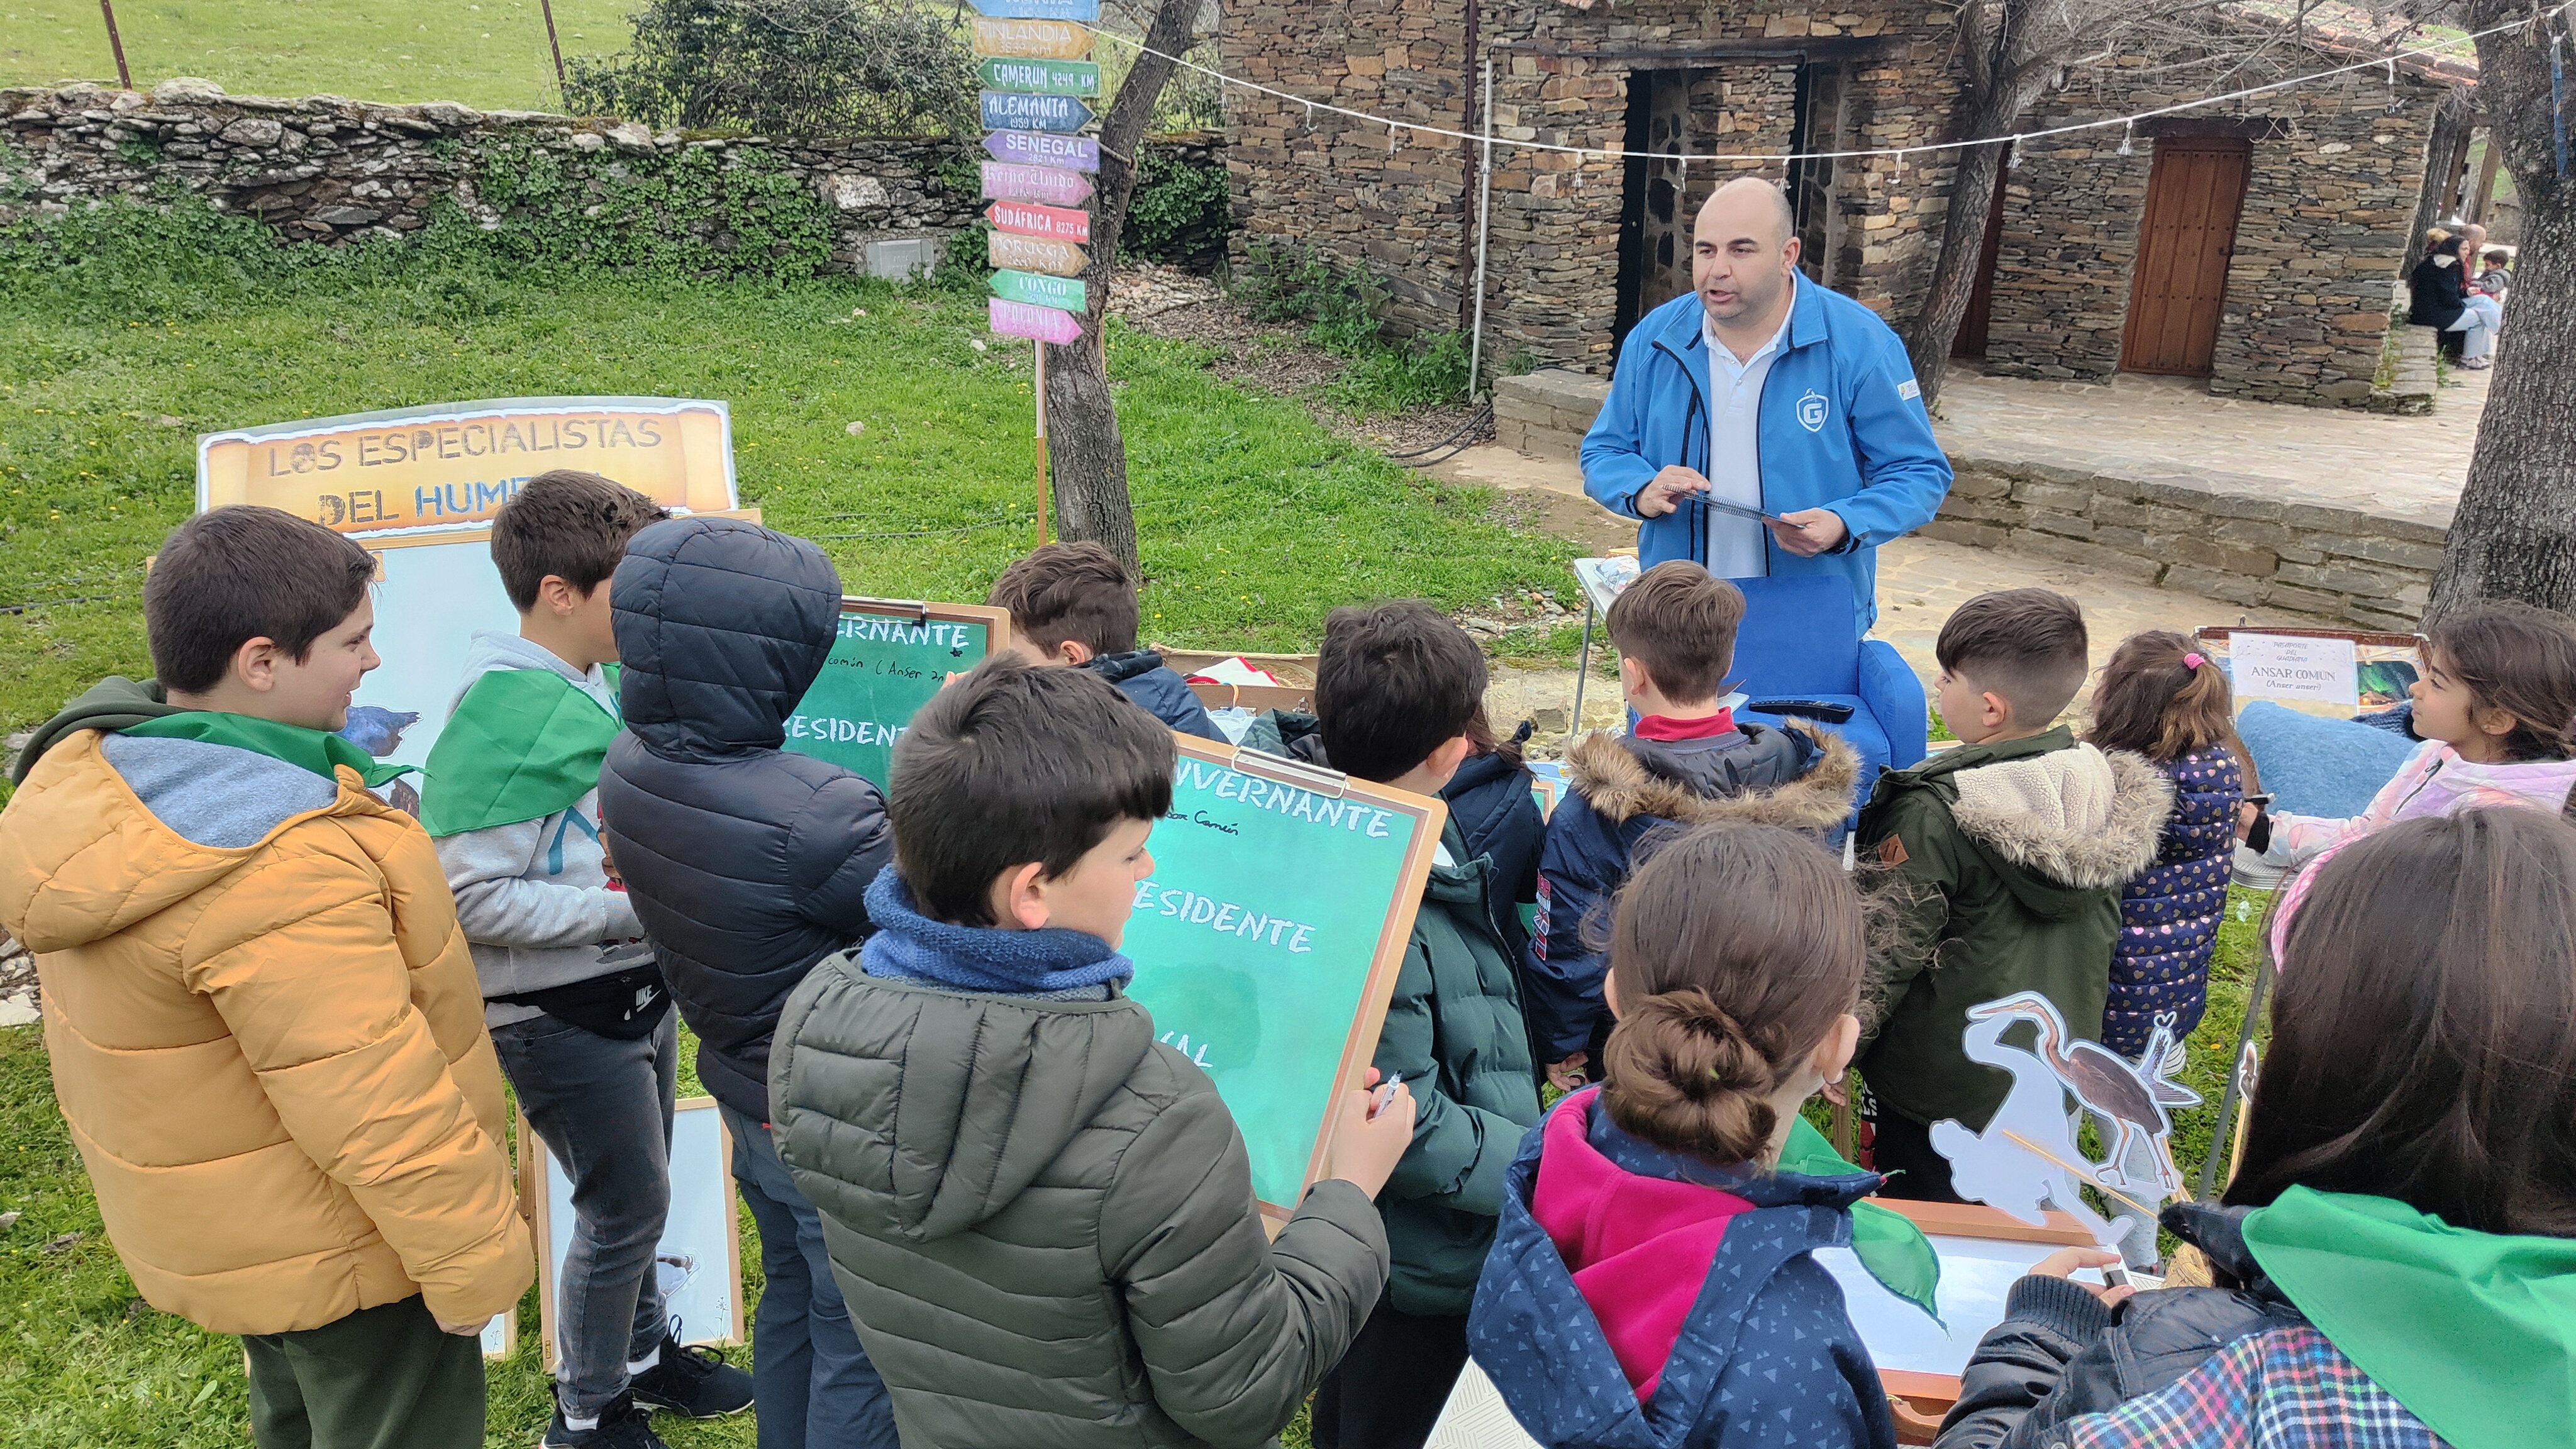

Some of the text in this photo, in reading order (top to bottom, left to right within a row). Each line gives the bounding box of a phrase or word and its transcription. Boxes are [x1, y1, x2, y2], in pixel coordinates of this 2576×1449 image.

[977, 21, 1072, 42] FINLANDIA
[1052, 72, 1074, 87] 4249
[1081, 74, 1094, 91] KM
[989, 95, 1069, 118] ALEMANIA
[1010, 118, 1046, 130] 1959 KM
[1006, 135, 1088, 157] SENEGAL
[1028, 153, 1065, 165] 2821 Km
[983, 165, 1074, 188] Reino Unido
[994, 205, 1051, 231] SUDÁFRICA
[1056, 221, 1074, 234] 8275
[993, 236, 1070, 258] NORUEGA
[1019, 275, 1067, 296] CONGO
[1002, 303, 1059, 330] POLONIA
[268, 418, 662, 477] LOS ESPECIALISTAS
[318, 476, 532, 526] DEL HUME
[2251, 667, 2293, 679] ANSAR
[2266, 679, 2294, 689] (Anser
[782, 714, 909, 748] ESIDEN
[1175, 760, 1394, 838] NVERNANTE
[1132, 880, 1317, 953] ESIDENTE
